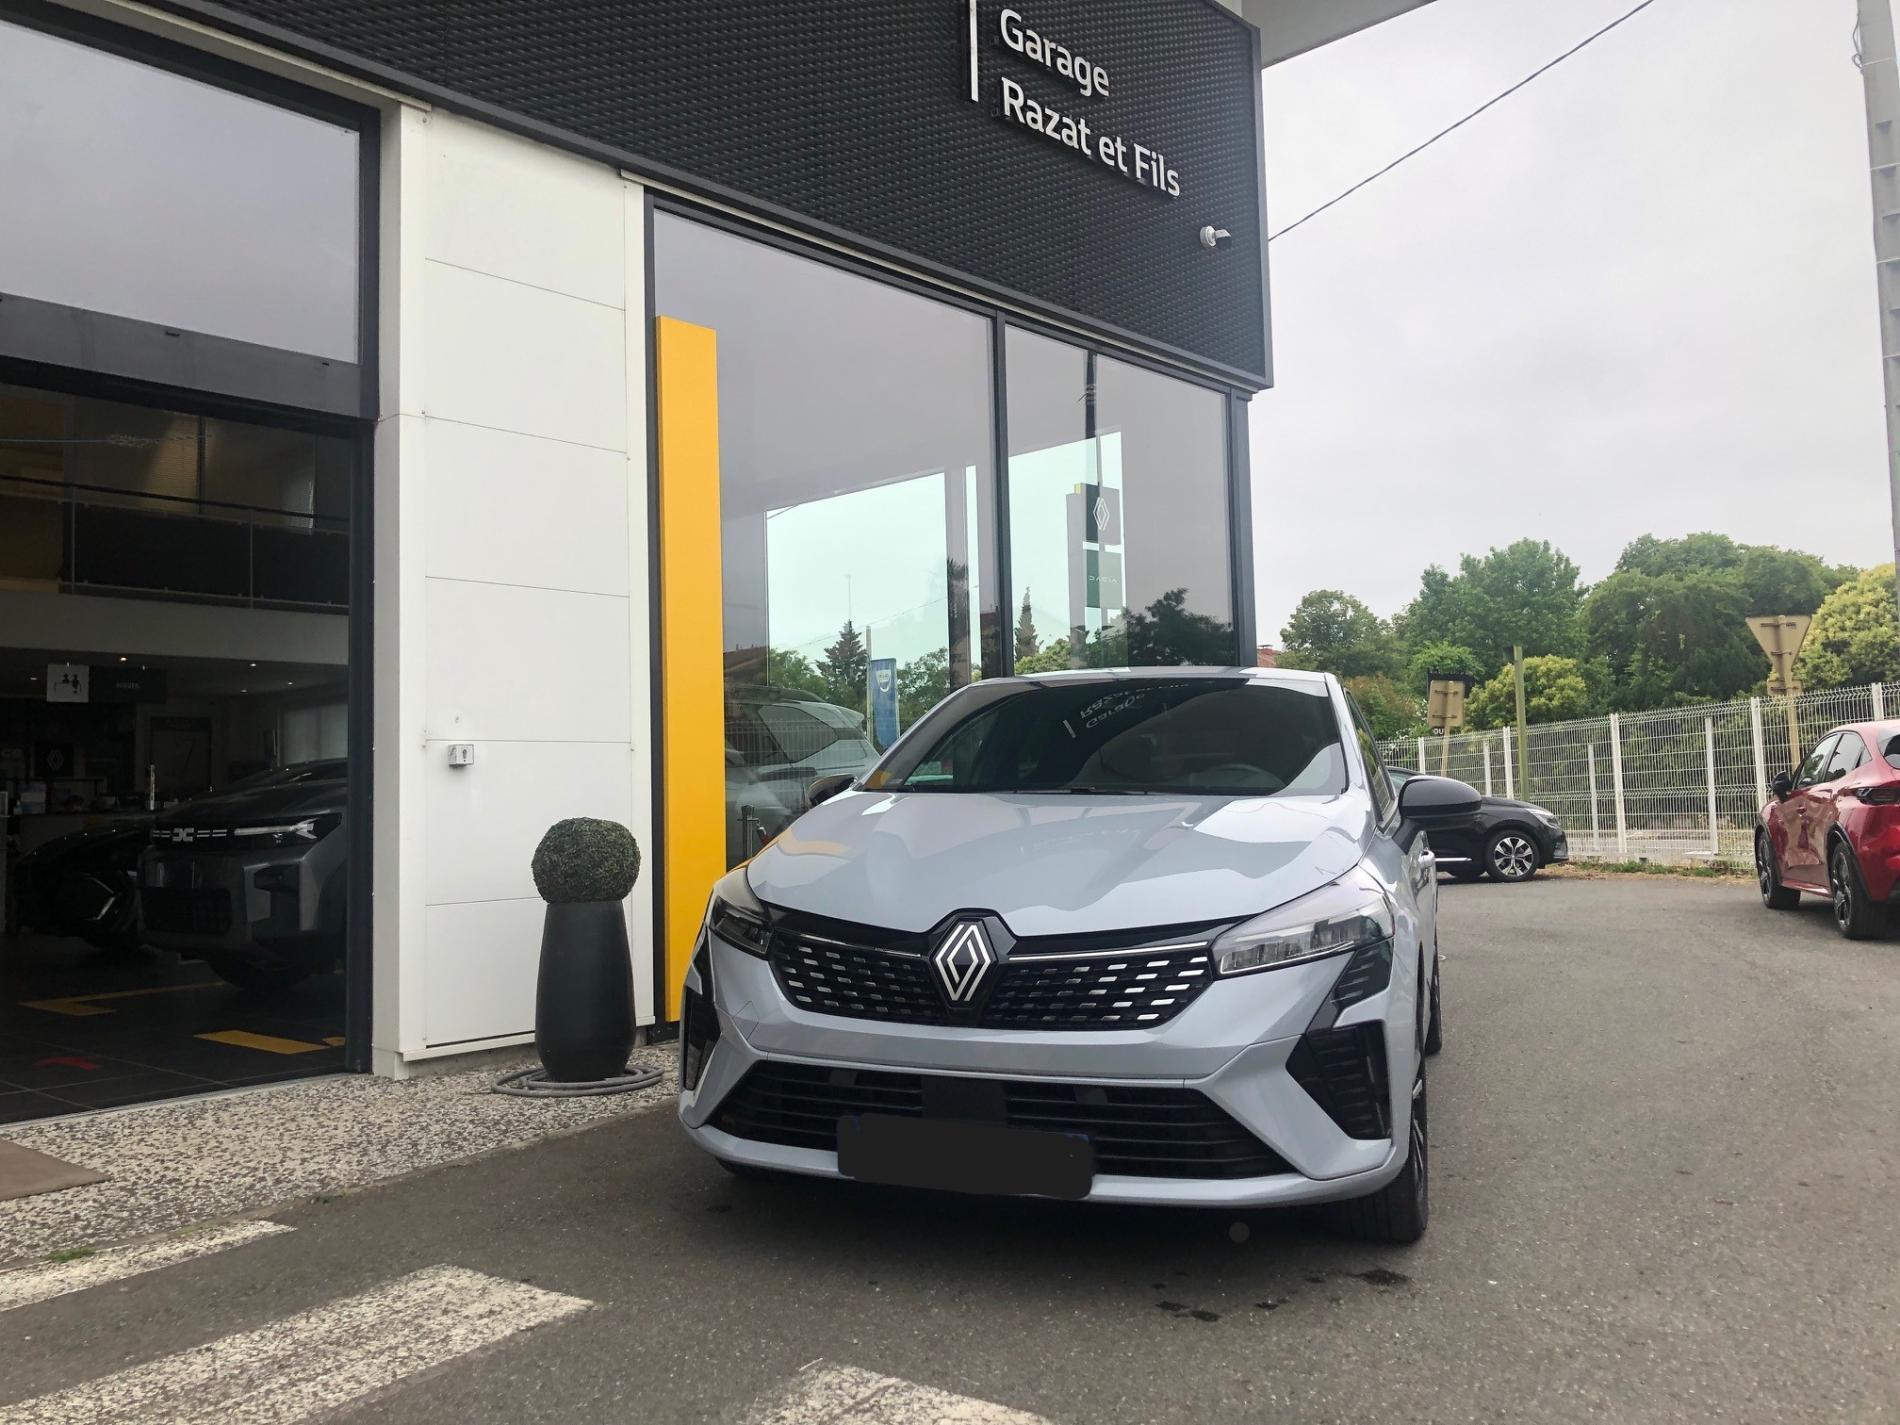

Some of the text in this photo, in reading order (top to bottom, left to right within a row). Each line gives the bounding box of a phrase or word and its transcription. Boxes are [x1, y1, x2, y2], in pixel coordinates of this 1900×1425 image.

[1000, 8, 1109, 97] Garage
[1001, 77, 1180, 197] Razat et Fils
